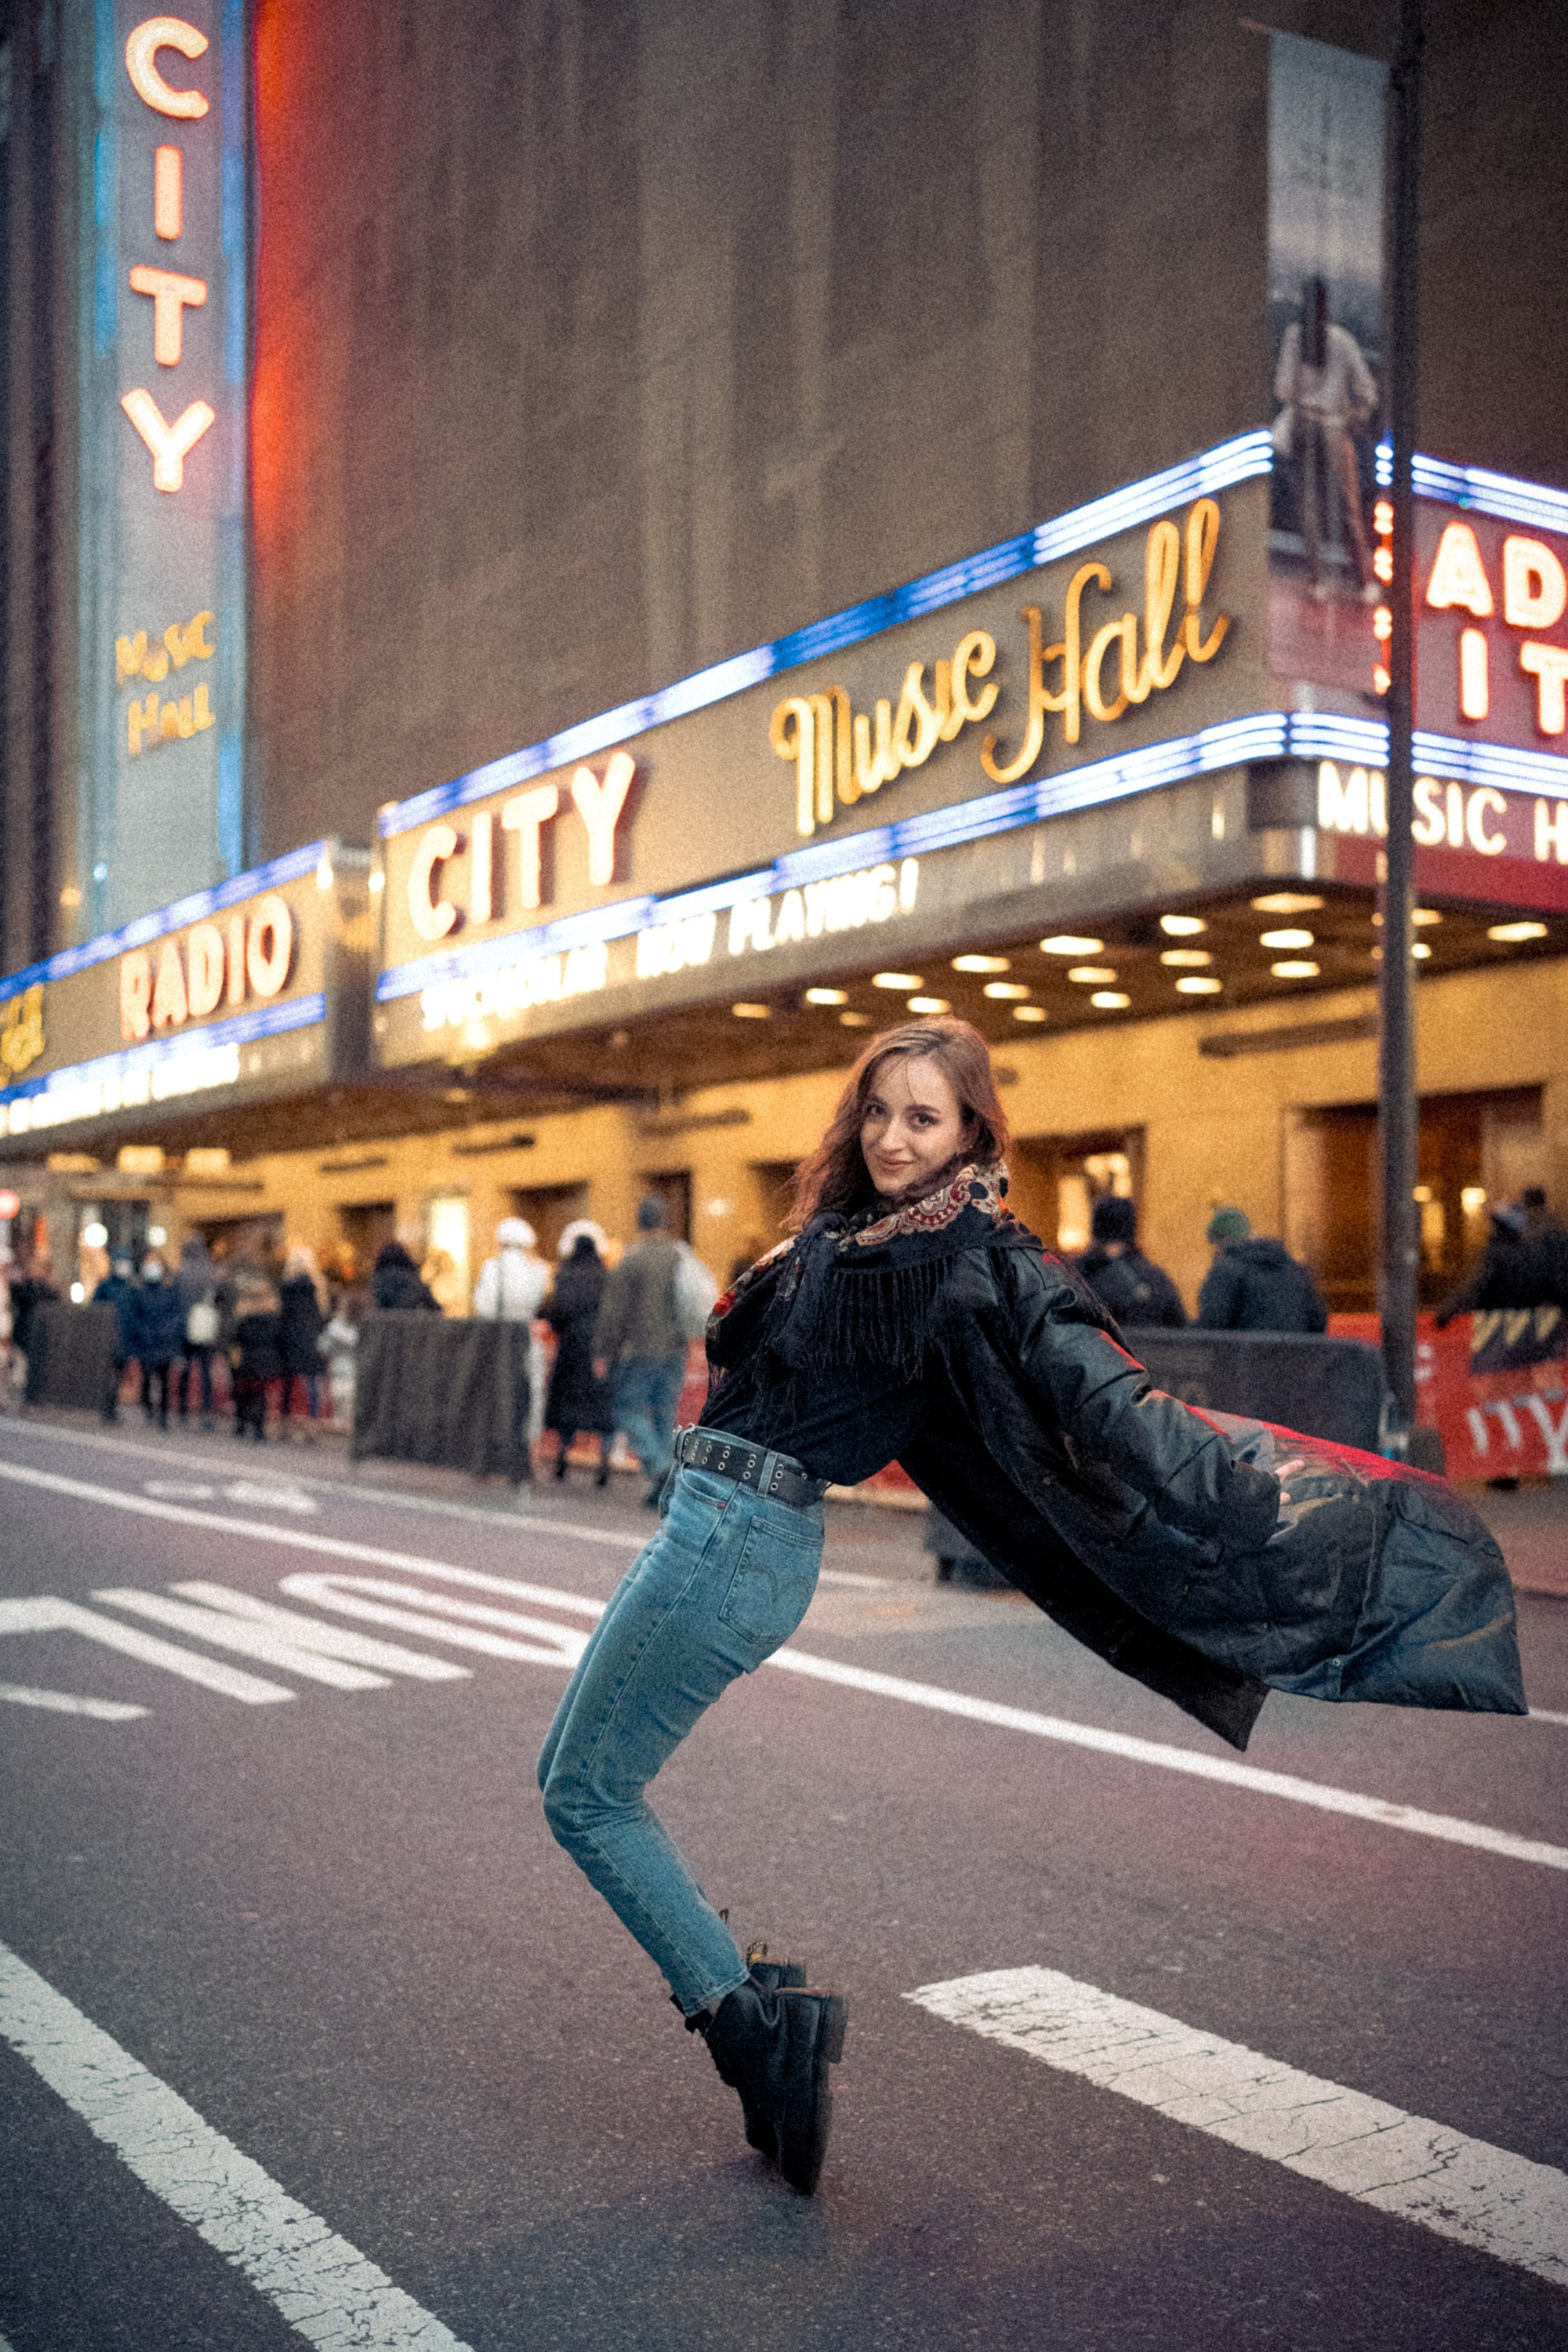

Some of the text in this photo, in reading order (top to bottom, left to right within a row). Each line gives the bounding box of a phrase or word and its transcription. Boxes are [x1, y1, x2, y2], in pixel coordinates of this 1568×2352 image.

[122, 16, 216, 493] CITY
[769, 498, 1232, 837] Music Hall
[119, 895, 293, 1042] RADIO
[407, 749, 637, 942] CITY
